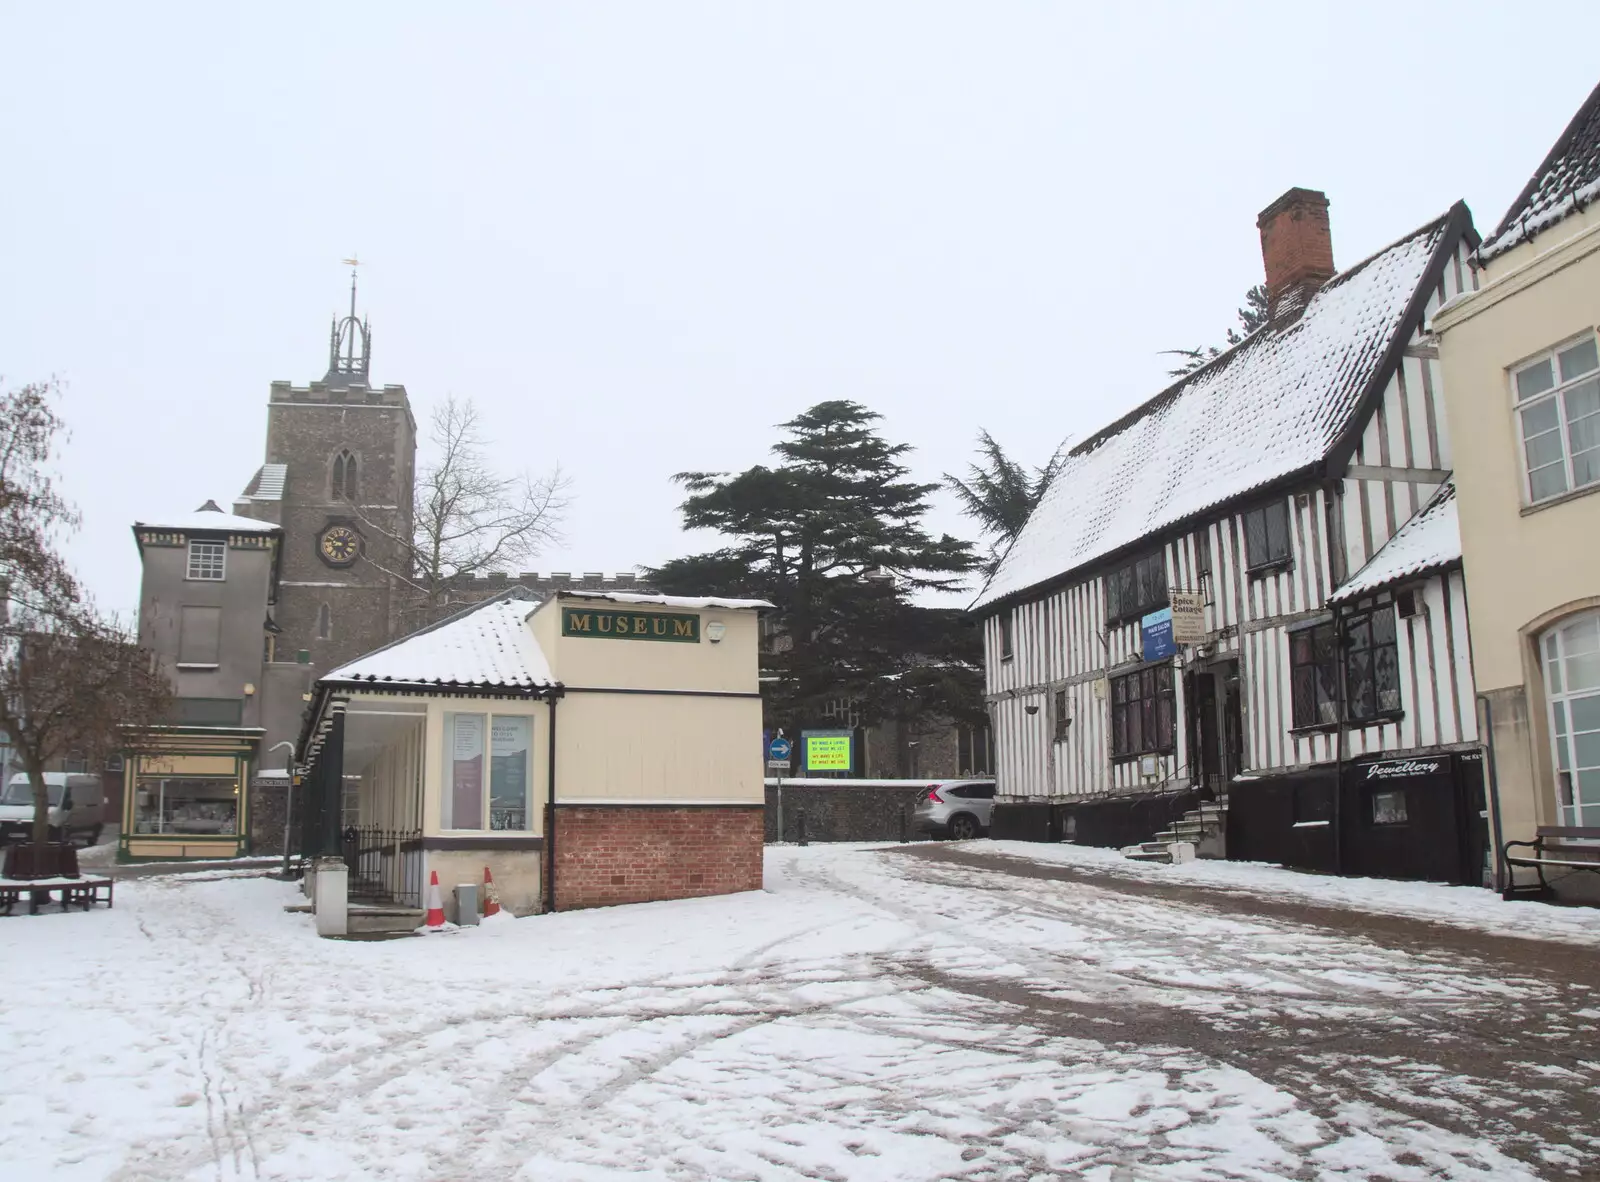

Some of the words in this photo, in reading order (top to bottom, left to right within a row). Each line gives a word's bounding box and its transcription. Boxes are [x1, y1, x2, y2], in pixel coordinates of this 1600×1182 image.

[1173, 595, 1194, 605] Spice
[1173, 605, 1202, 614] Cottage
[569, 613, 693, 637] MUSEUM
[1157, 622, 1170, 631] SALON
[1367, 761, 1439, 779] Jewellery
